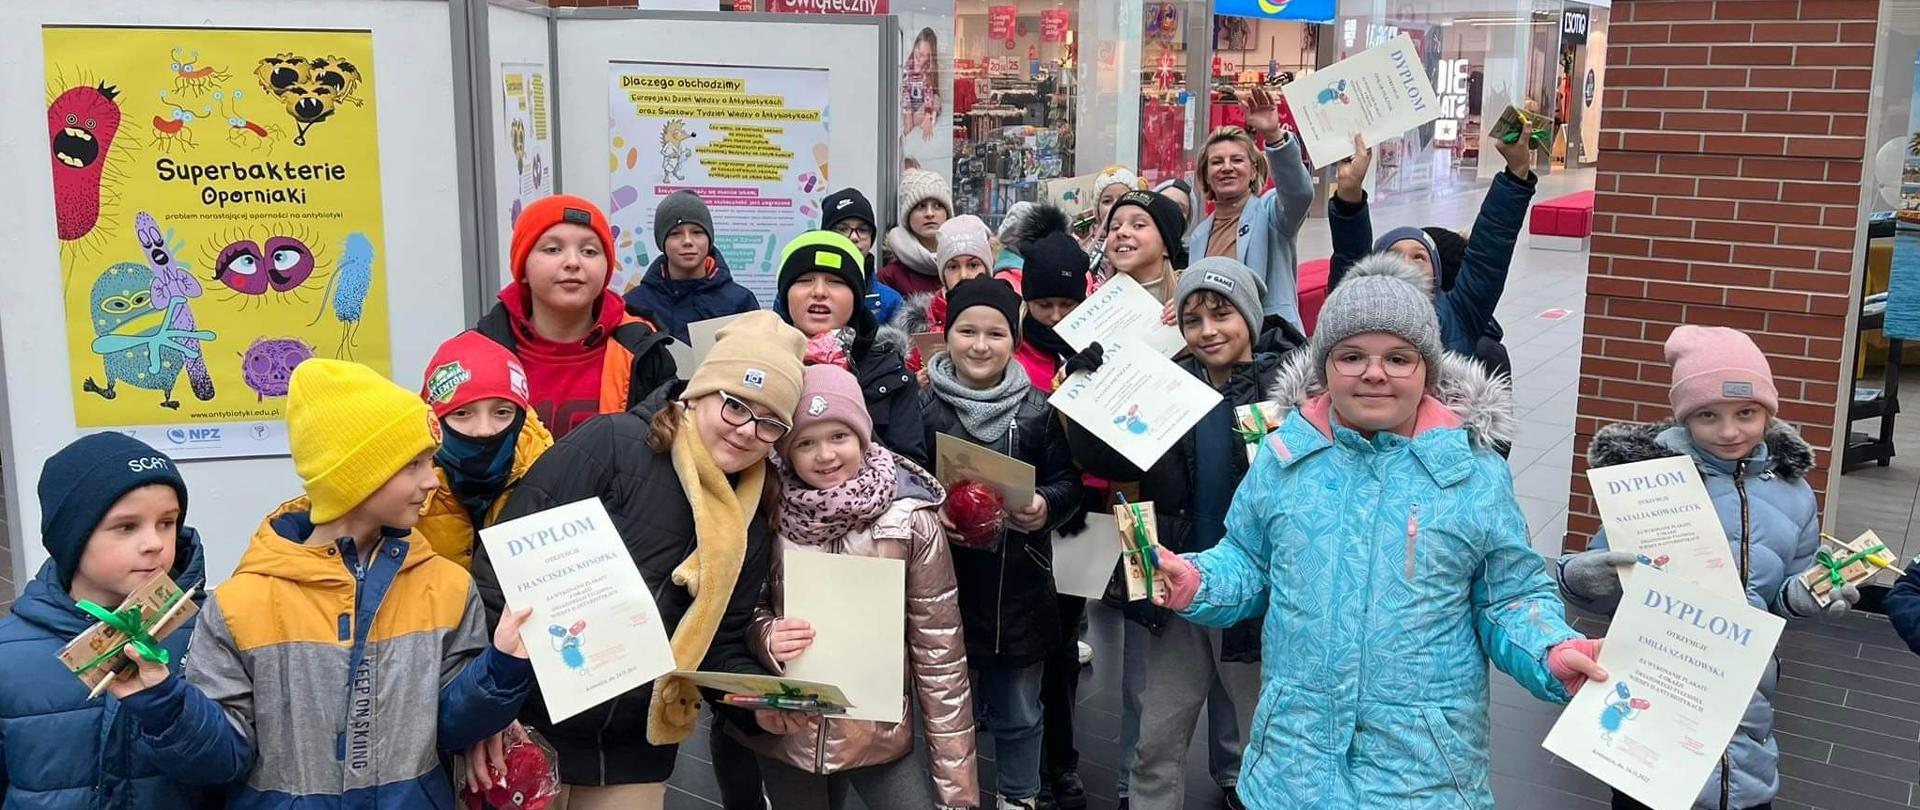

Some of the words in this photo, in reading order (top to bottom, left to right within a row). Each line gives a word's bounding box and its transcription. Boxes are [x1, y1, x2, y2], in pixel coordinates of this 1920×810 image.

[1564, 12, 1586, 35] ESOTIQ
[1224, 62, 1234, 72] 10
[623, 76, 674, 90] Dlaczego
[678, 78, 741, 91] obchodzimy
[1391, 50, 1425, 110] DYPLOM
[631, 94, 671, 104] Europejski
[672, 94, 692, 104] Dzień
[694, 96, 720, 106] Wiedzy
[728, 97, 782, 106] Antybiotykach
[638, 108, 657, 116] oraz
[658, 106, 694, 117] Światowy
[696, 108, 726, 118] Tydzień
[727, 110, 752, 119] Wiedzy
[762, 111, 819, 120] Antybiotykach?
[156, 157, 346, 184] Superbakterie
[201, 186, 306, 208] Oporniaki
[165, 212, 198, 221] problem
[199, 212, 248, 221] narastającej
[250, 211, 288, 220] oporności
[290, 212, 300, 220] na
[302, 212, 344, 220] antybiotyki
[1213, 276, 1232, 288] GAME
[1070, 285, 1122, 329] DYPLOM
[190, 408, 280, 419] www.antybiotyki.edu.pl
[188, 428, 221, 440] NPZ
[128, 456, 168, 473] SCAT
[1608, 471, 1684, 493] DYPLOM
[1615, 511, 1650, 523] NATALIA
[1650, 503, 1701, 517] KOWALCZYK
[507, 516, 595, 555] DYPLOM
[516, 565, 575, 591] FRANCISZEK
[575, 550, 617, 570] KONOPKA
[1642, 589, 1752, 644] DYPLOM
[1637, 635, 1668, 653] EMILIA
[1667, 647, 1725, 677] SZATKOWSKA
[355, 659, 370, 694] KEEP
[356, 699, 370, 718] ON
[352, 721, 370, 770] SKIING
